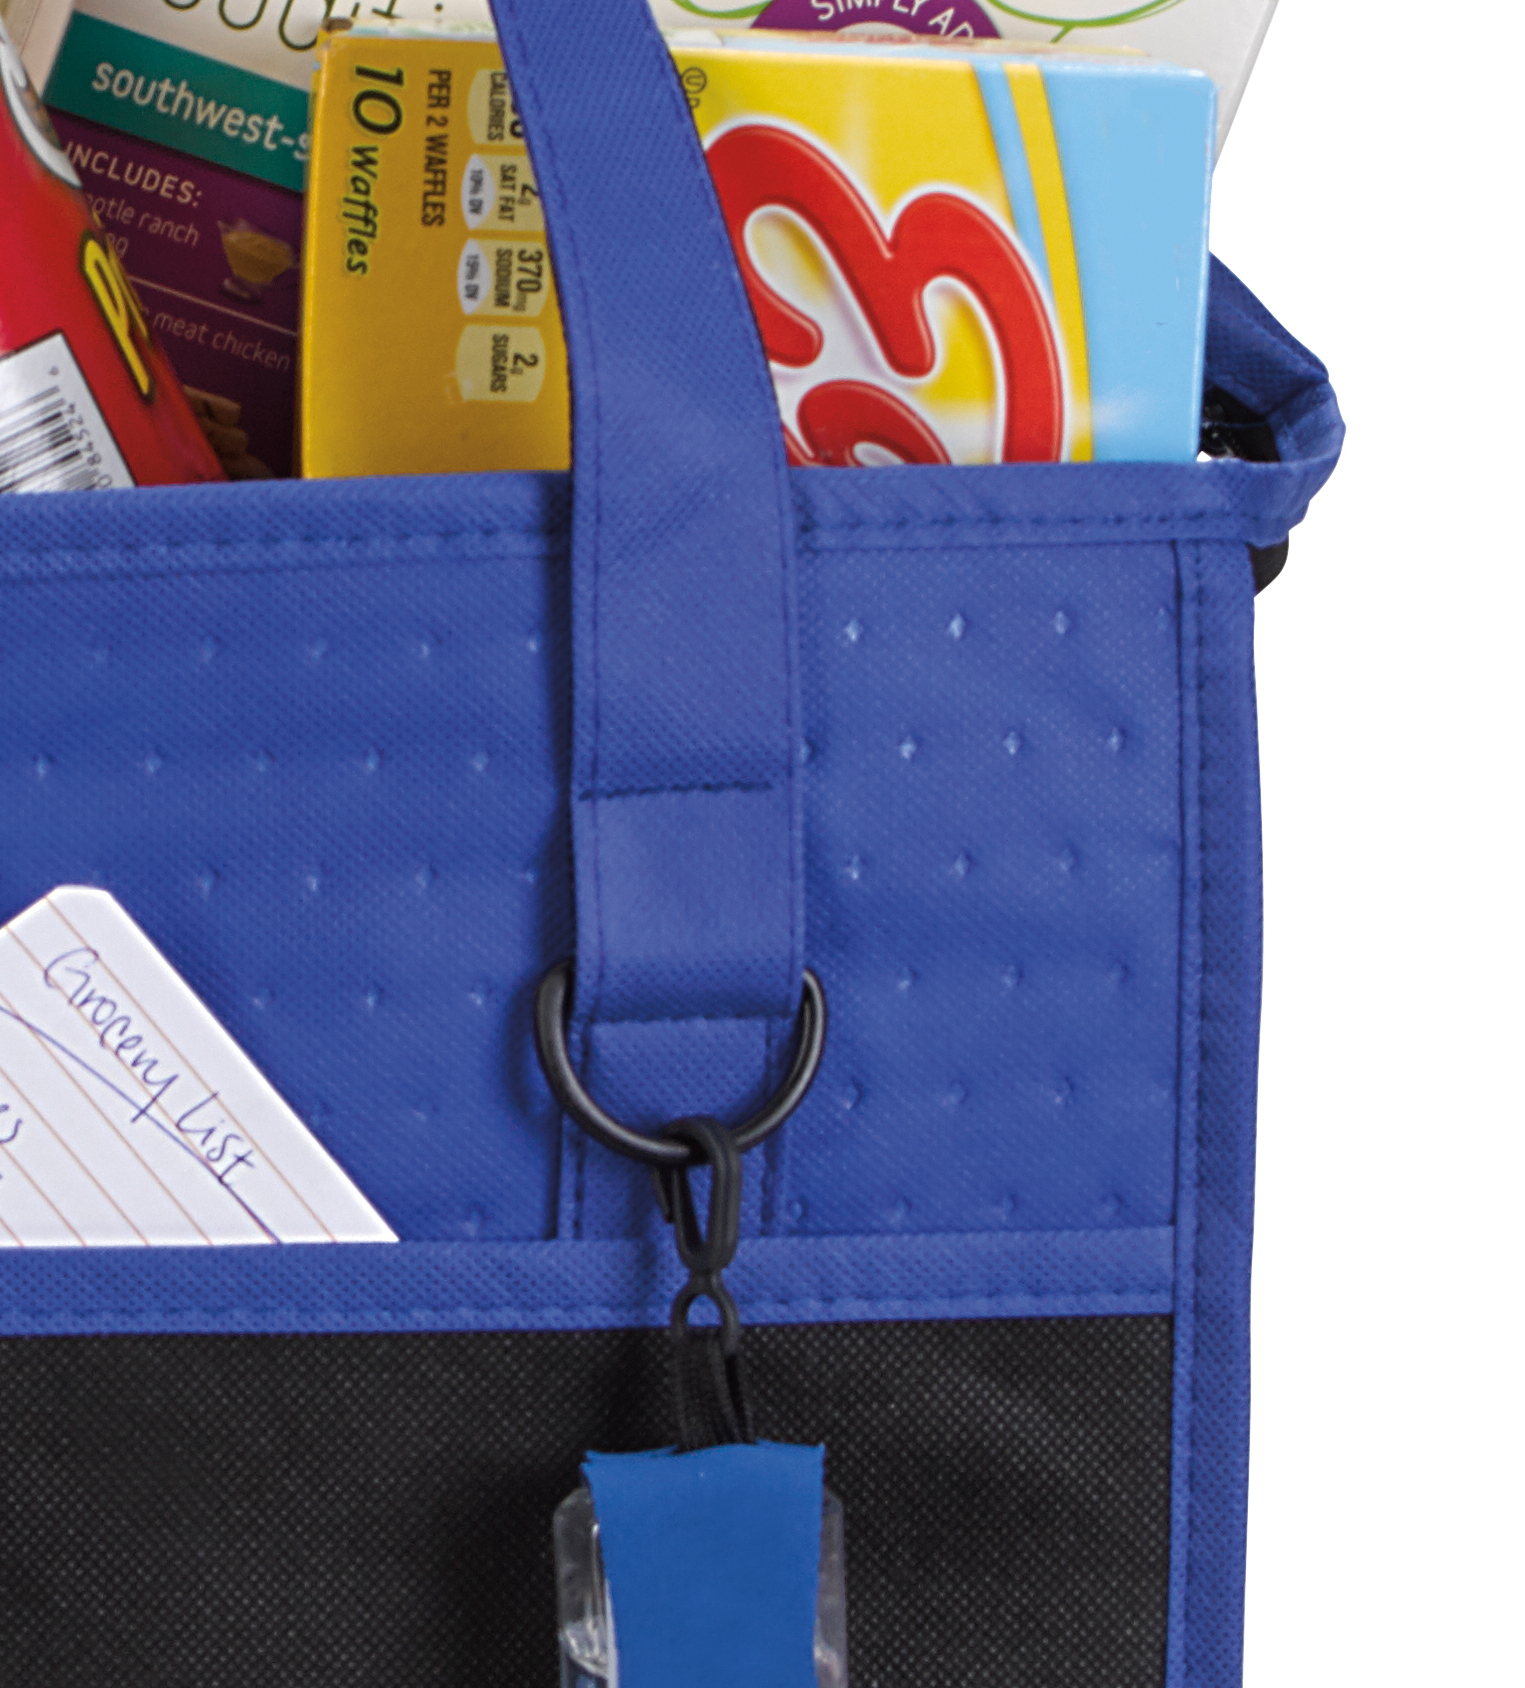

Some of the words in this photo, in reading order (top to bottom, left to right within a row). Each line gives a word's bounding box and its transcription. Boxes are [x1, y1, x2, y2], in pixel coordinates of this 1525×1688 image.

[351, 65, 404, 136] 10
[426, 68, 452, 109] PER
[487, 71, 507, 142] CALORIES
[426, 114, 450, 128] 2
[65, 141, 203, 208] INCLUDES:
[421, 133, 449, 228] WAFFLES
[499, 164, 517, 191] SAT
[138, 211, 201, 248] ranch
[497, 195, 515, 223] FAT
[494, 248, 512, 307] SODIUM
[153, 311, 210, 345] meat
[211, 328, 291, 373] chicken
[488, 333, 510, 394] SUGARS
[42, 946, 179, 1123] Grocery
